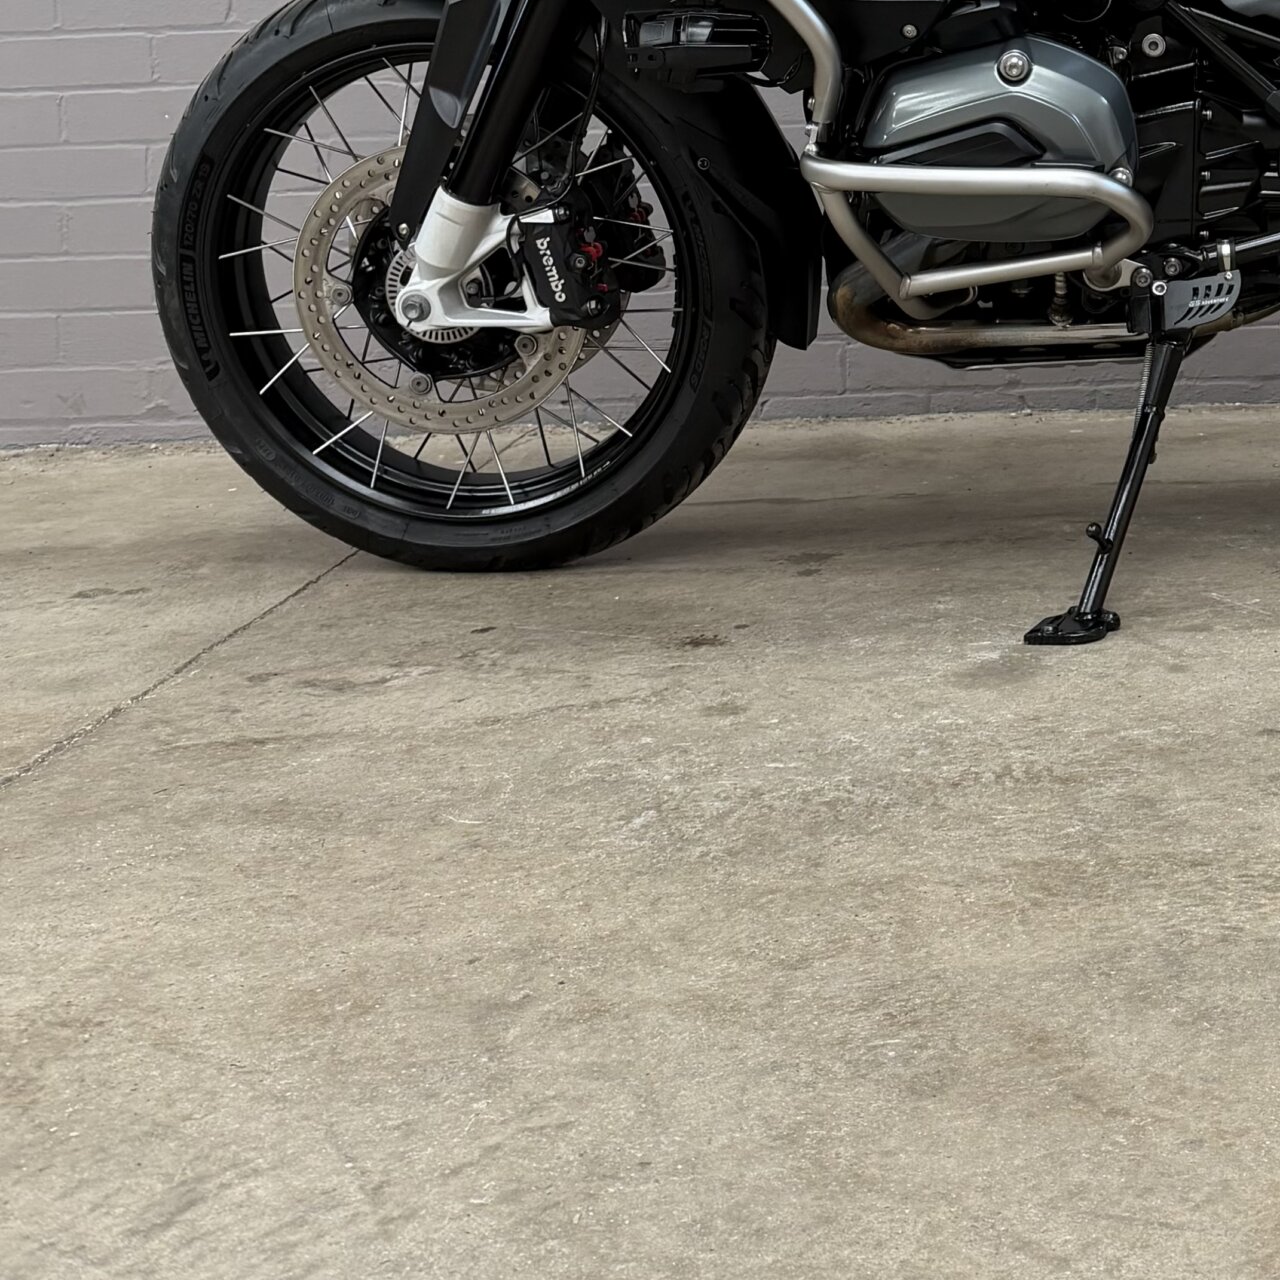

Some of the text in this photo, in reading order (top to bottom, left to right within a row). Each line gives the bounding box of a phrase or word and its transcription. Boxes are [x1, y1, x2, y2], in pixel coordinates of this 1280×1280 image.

[192, 180, 206, 199] ZR
[183, 202, 199, 248] 120/70
[535, 236, 567, 303] brembo
[181, 261, 210, 349] MICHELIN
